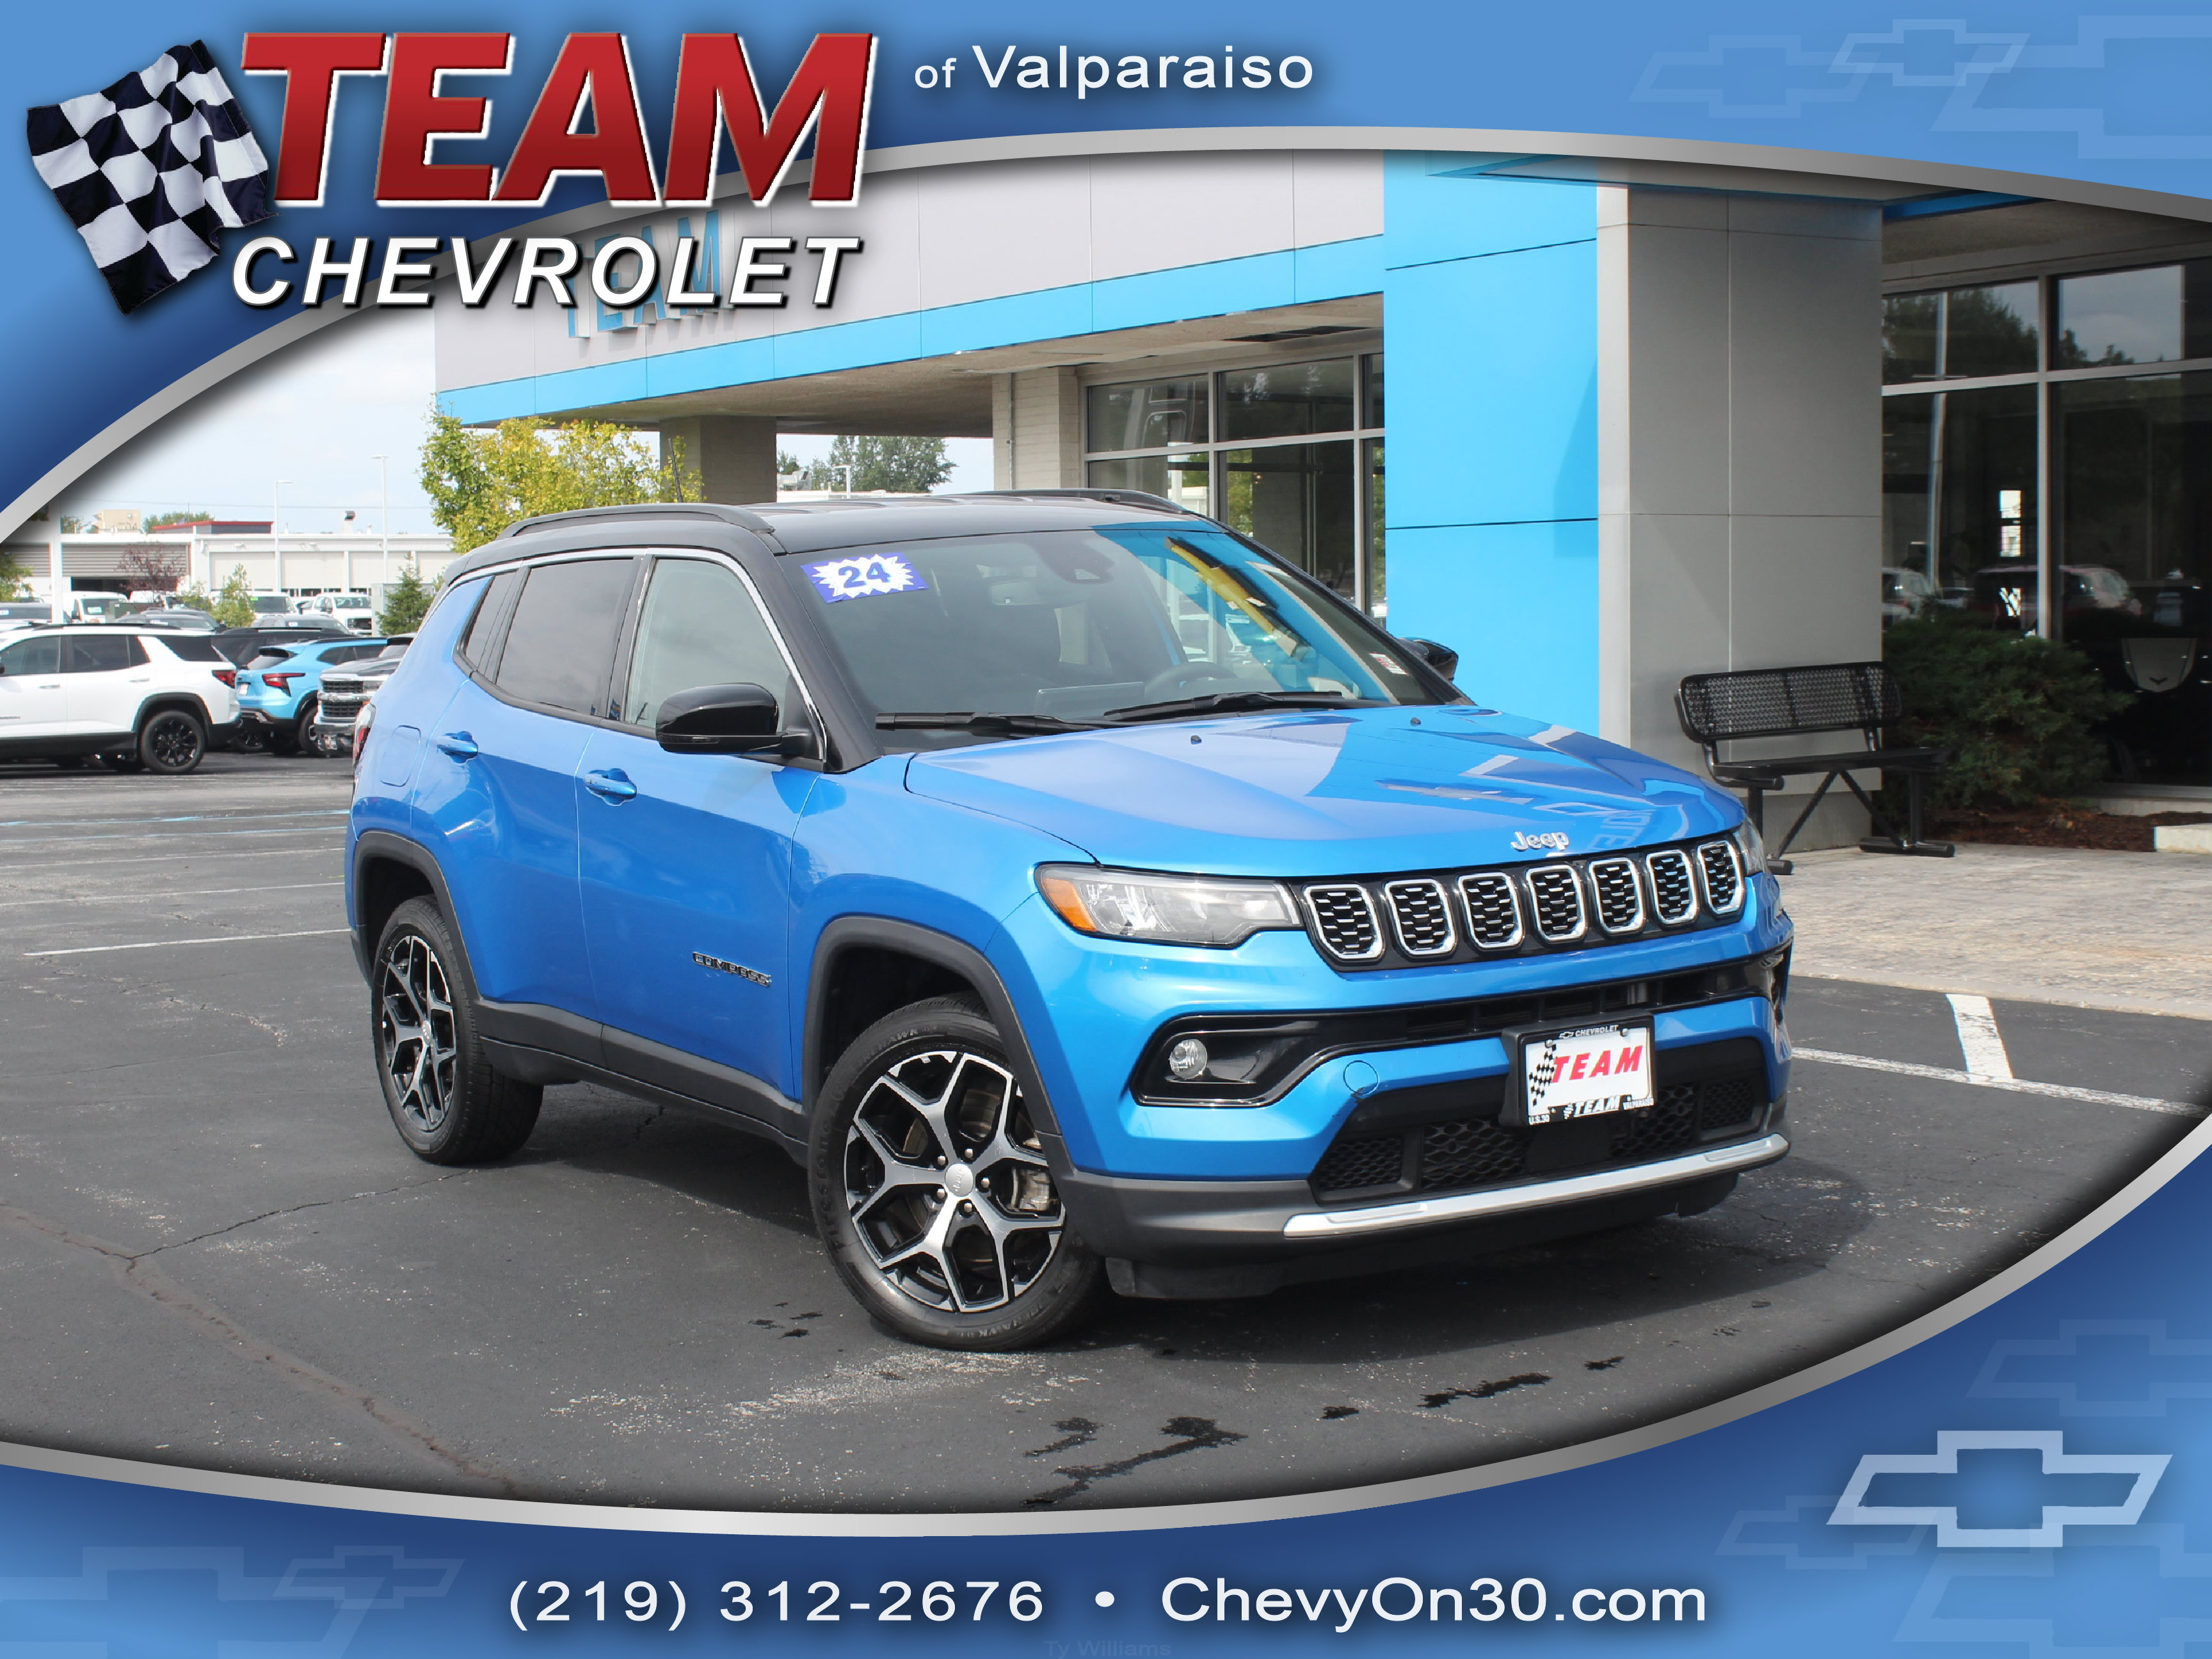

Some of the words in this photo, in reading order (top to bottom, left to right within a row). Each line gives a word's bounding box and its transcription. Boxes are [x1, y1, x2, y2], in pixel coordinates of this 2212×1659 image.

[838, 562, 890, 588] 24
[1511, 831, 1569, 851] Jeep
[692, 951, 772, 987] COMPASS
[1575, 1025, 1619, 1037] CHEVROLET
[1551, 1045, 1643, 1083] TEAM
[1573, 1095, 1620, 1117] TEAM
